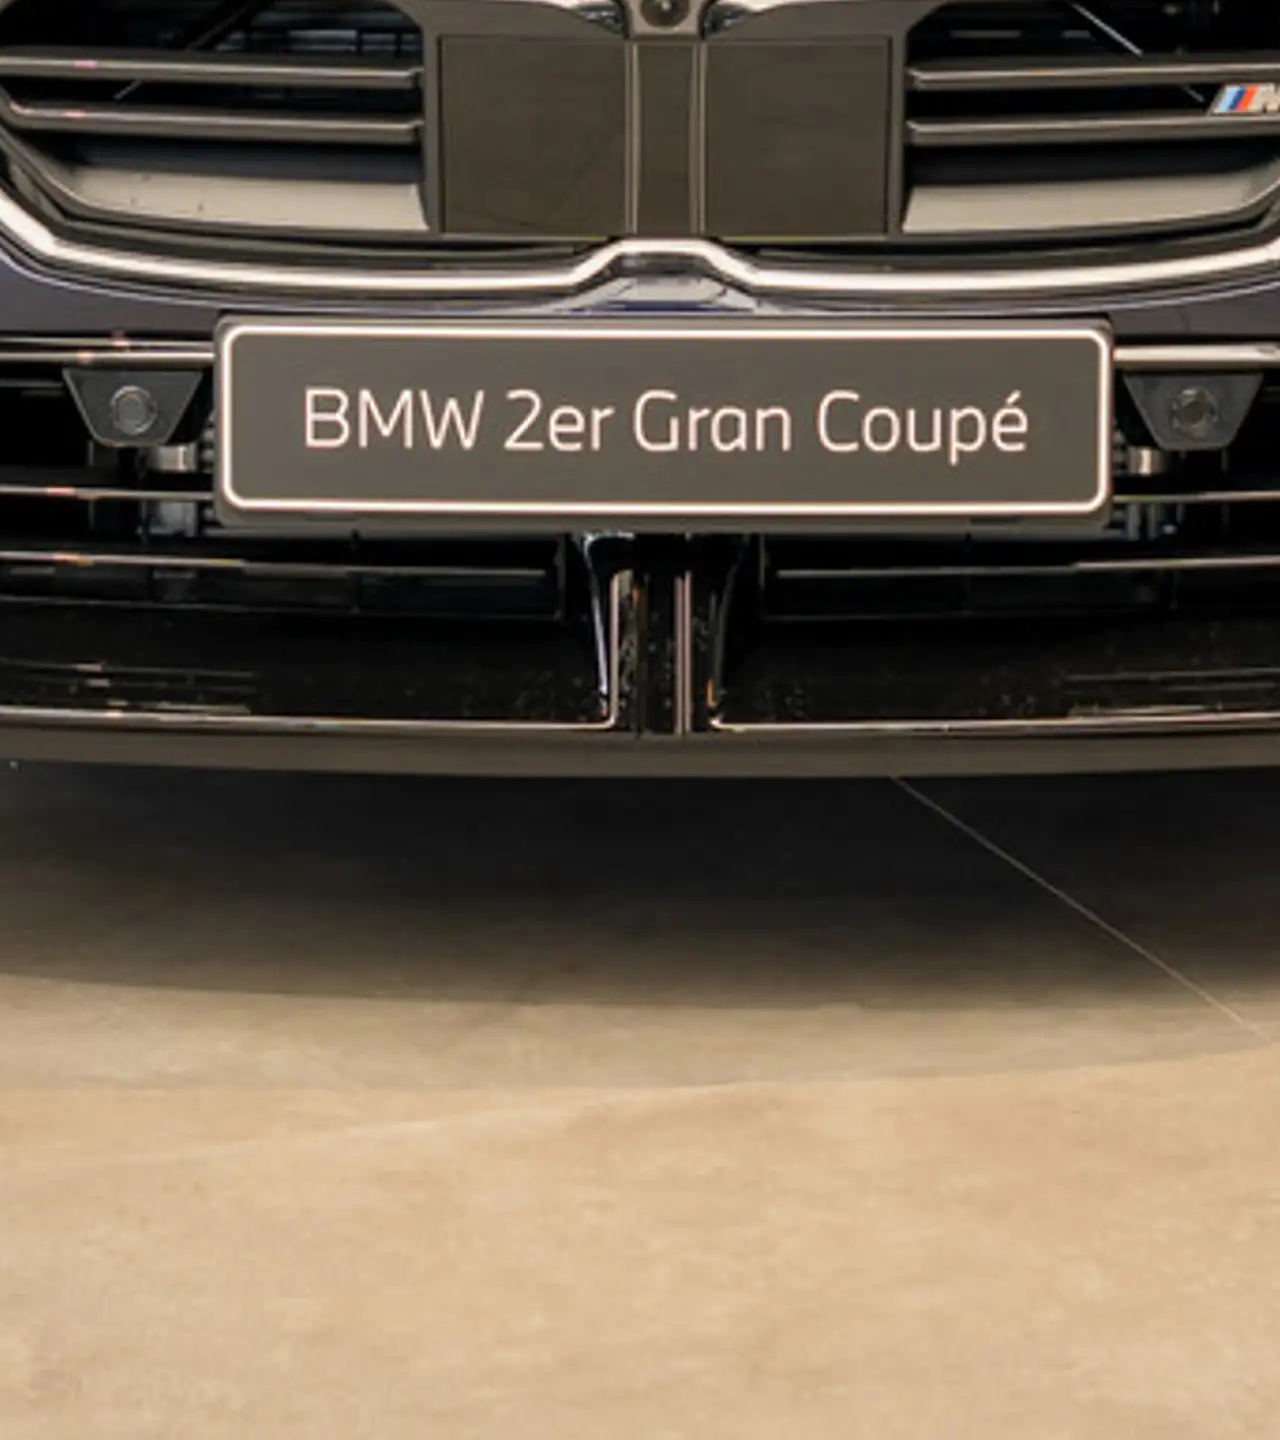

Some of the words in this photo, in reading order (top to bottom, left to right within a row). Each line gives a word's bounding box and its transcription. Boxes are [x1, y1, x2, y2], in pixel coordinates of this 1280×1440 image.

[304, 386, 486, 450] BMW
[503, 388, 616, 452] 2er
[633, 389, 793, 453] Gran
[817, 389, 1029, 467] Coupé
